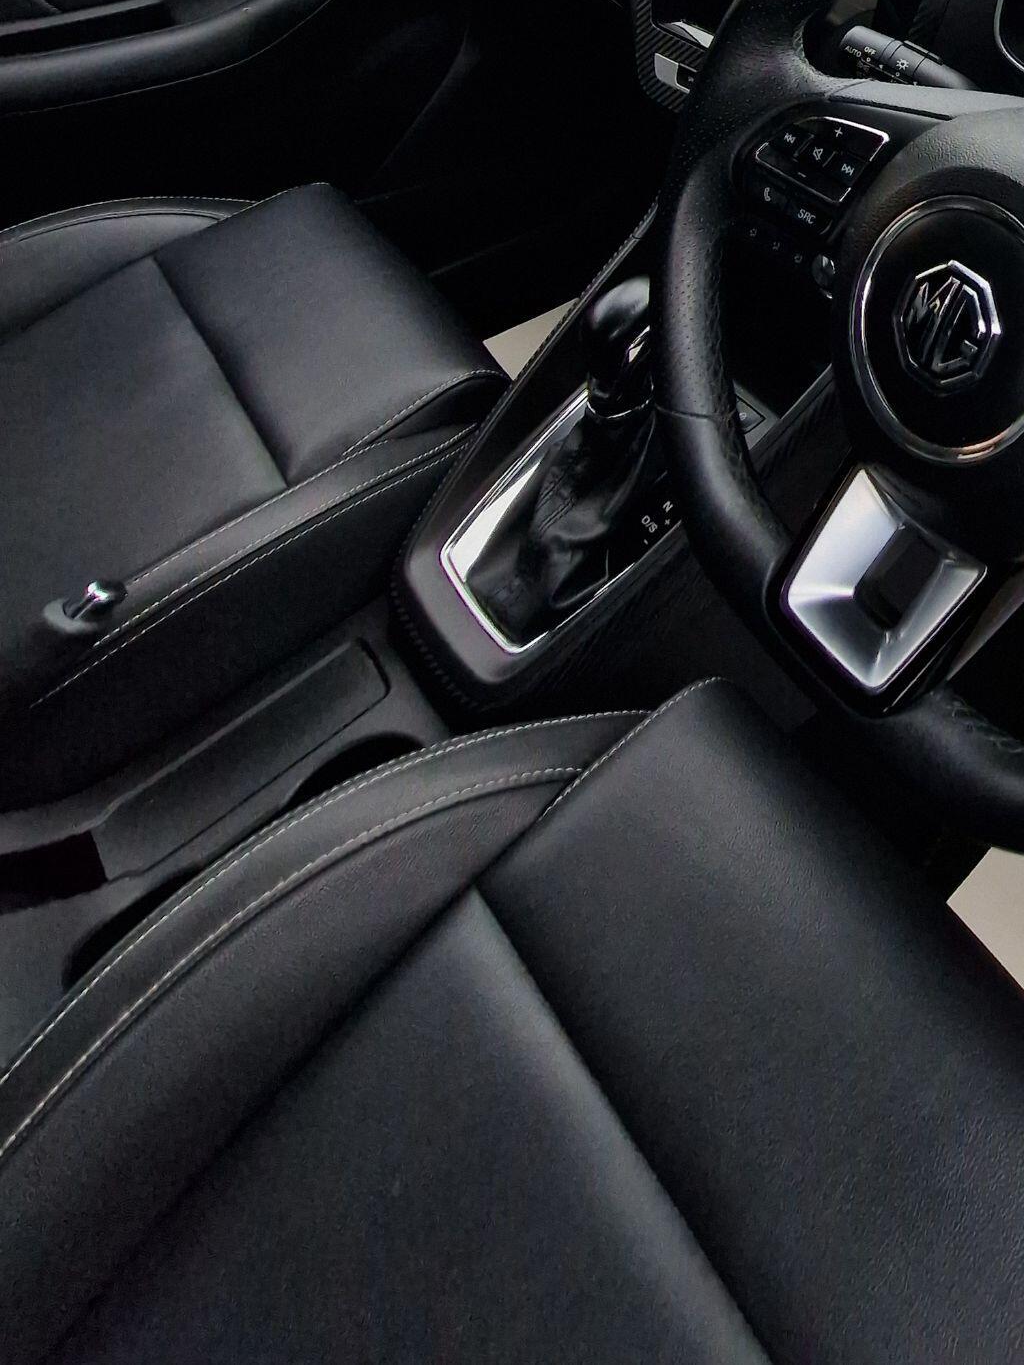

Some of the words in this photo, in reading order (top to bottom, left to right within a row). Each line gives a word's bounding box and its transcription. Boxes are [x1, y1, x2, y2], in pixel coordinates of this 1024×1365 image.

[844, 45, 862, 58] AUTO
[864, 46, 877, 56] OFF
[797, 208, 816, 225] SRC
[662, 500, 674, 513] N
[641, 515, 658, 533] D/S
